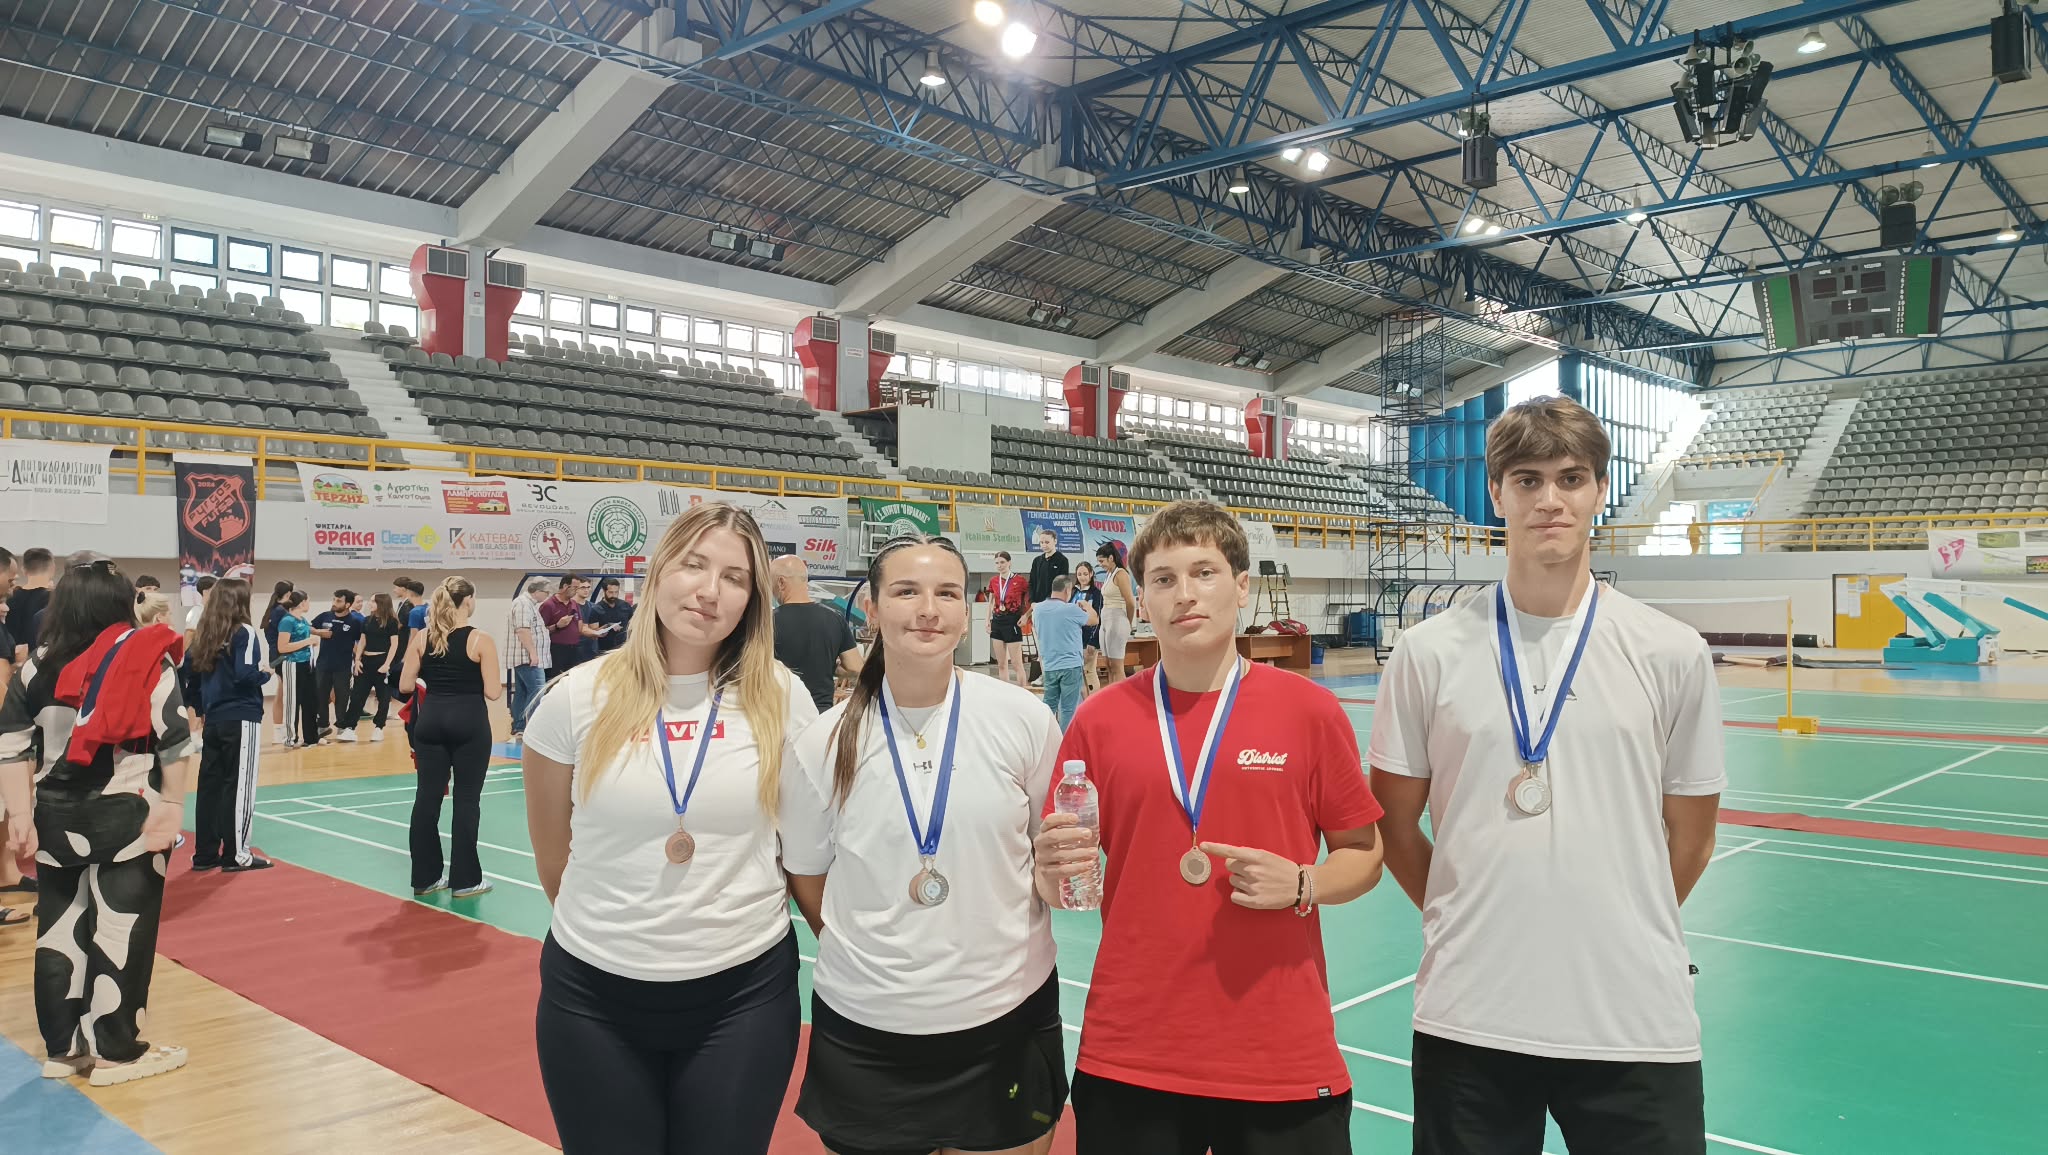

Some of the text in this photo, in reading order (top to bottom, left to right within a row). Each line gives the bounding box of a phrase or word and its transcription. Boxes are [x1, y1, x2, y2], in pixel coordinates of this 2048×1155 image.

[314, 492, 364, 504] ΤΕΡΖΗΣ
[315, 530, 375, 546] ΘΡΑΚΑ
[470, 533, 523, 544] ΚΑΤΕΒΑΣ
[965, 532, 1021, 543] Italian Studies
[804, 538, 838, 552] Silk
[1237, 749, 1288, 766] District
